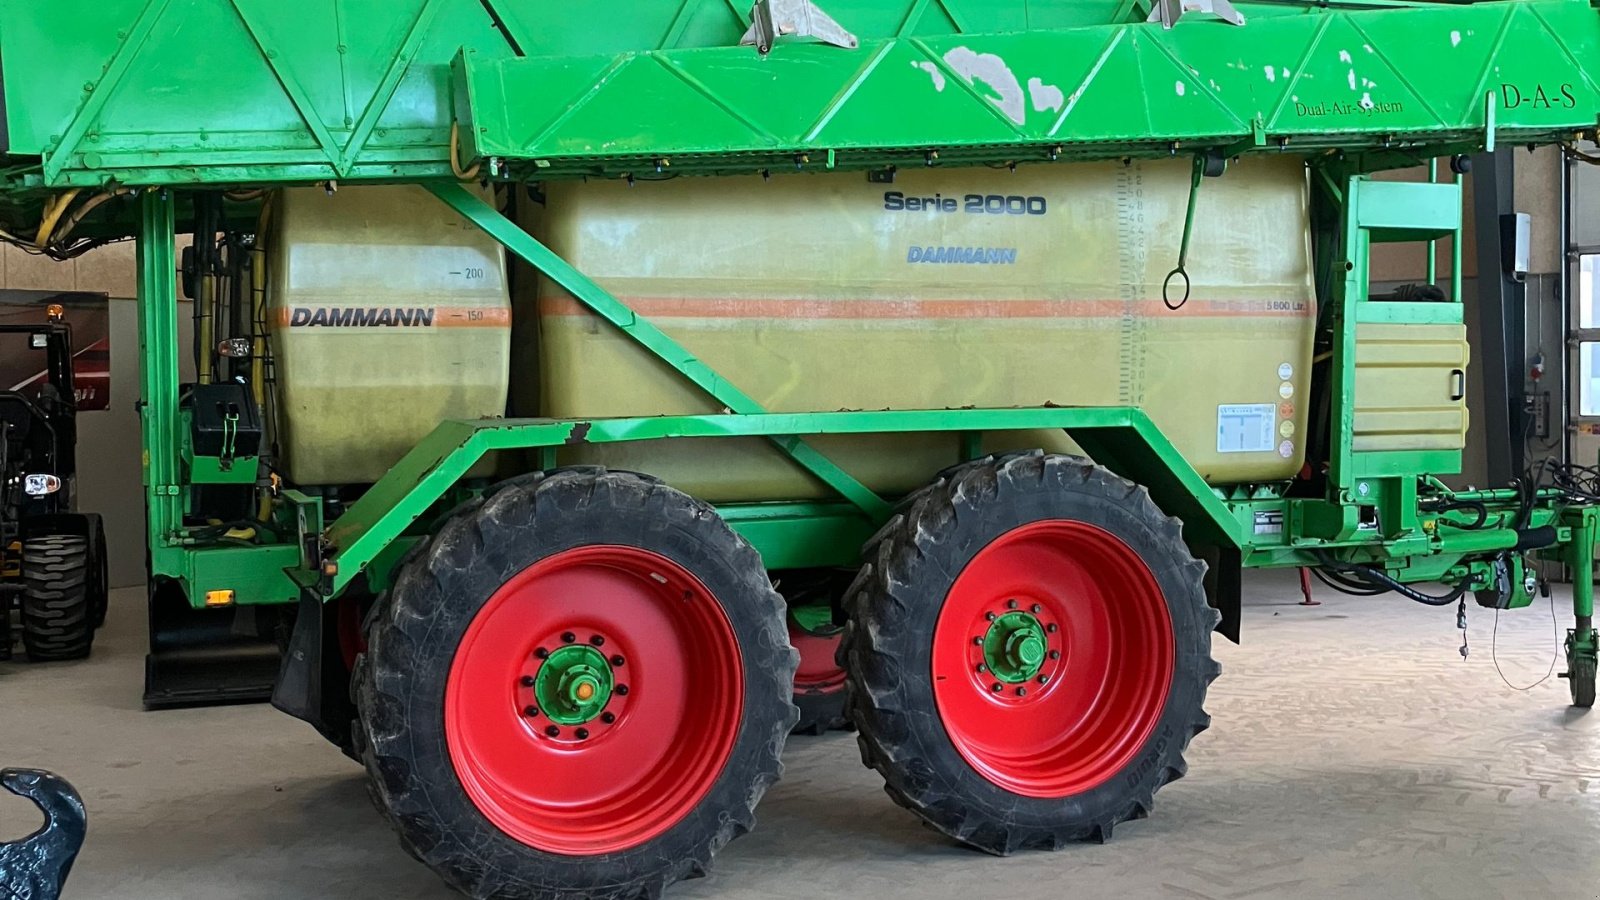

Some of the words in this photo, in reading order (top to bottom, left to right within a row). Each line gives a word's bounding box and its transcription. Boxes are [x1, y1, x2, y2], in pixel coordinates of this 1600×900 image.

[1501, 83, 1577, 109] D-A-S
[884, 191, 957, 213] Serie
[964, 194, 1047, 215] 2000
[907, 246, 1018, 263] DAMMANN
[465, 267, 484, 279] 200
[290, 308, 434, 327] DAMMANN
[467, 310, 484, 321] 150
